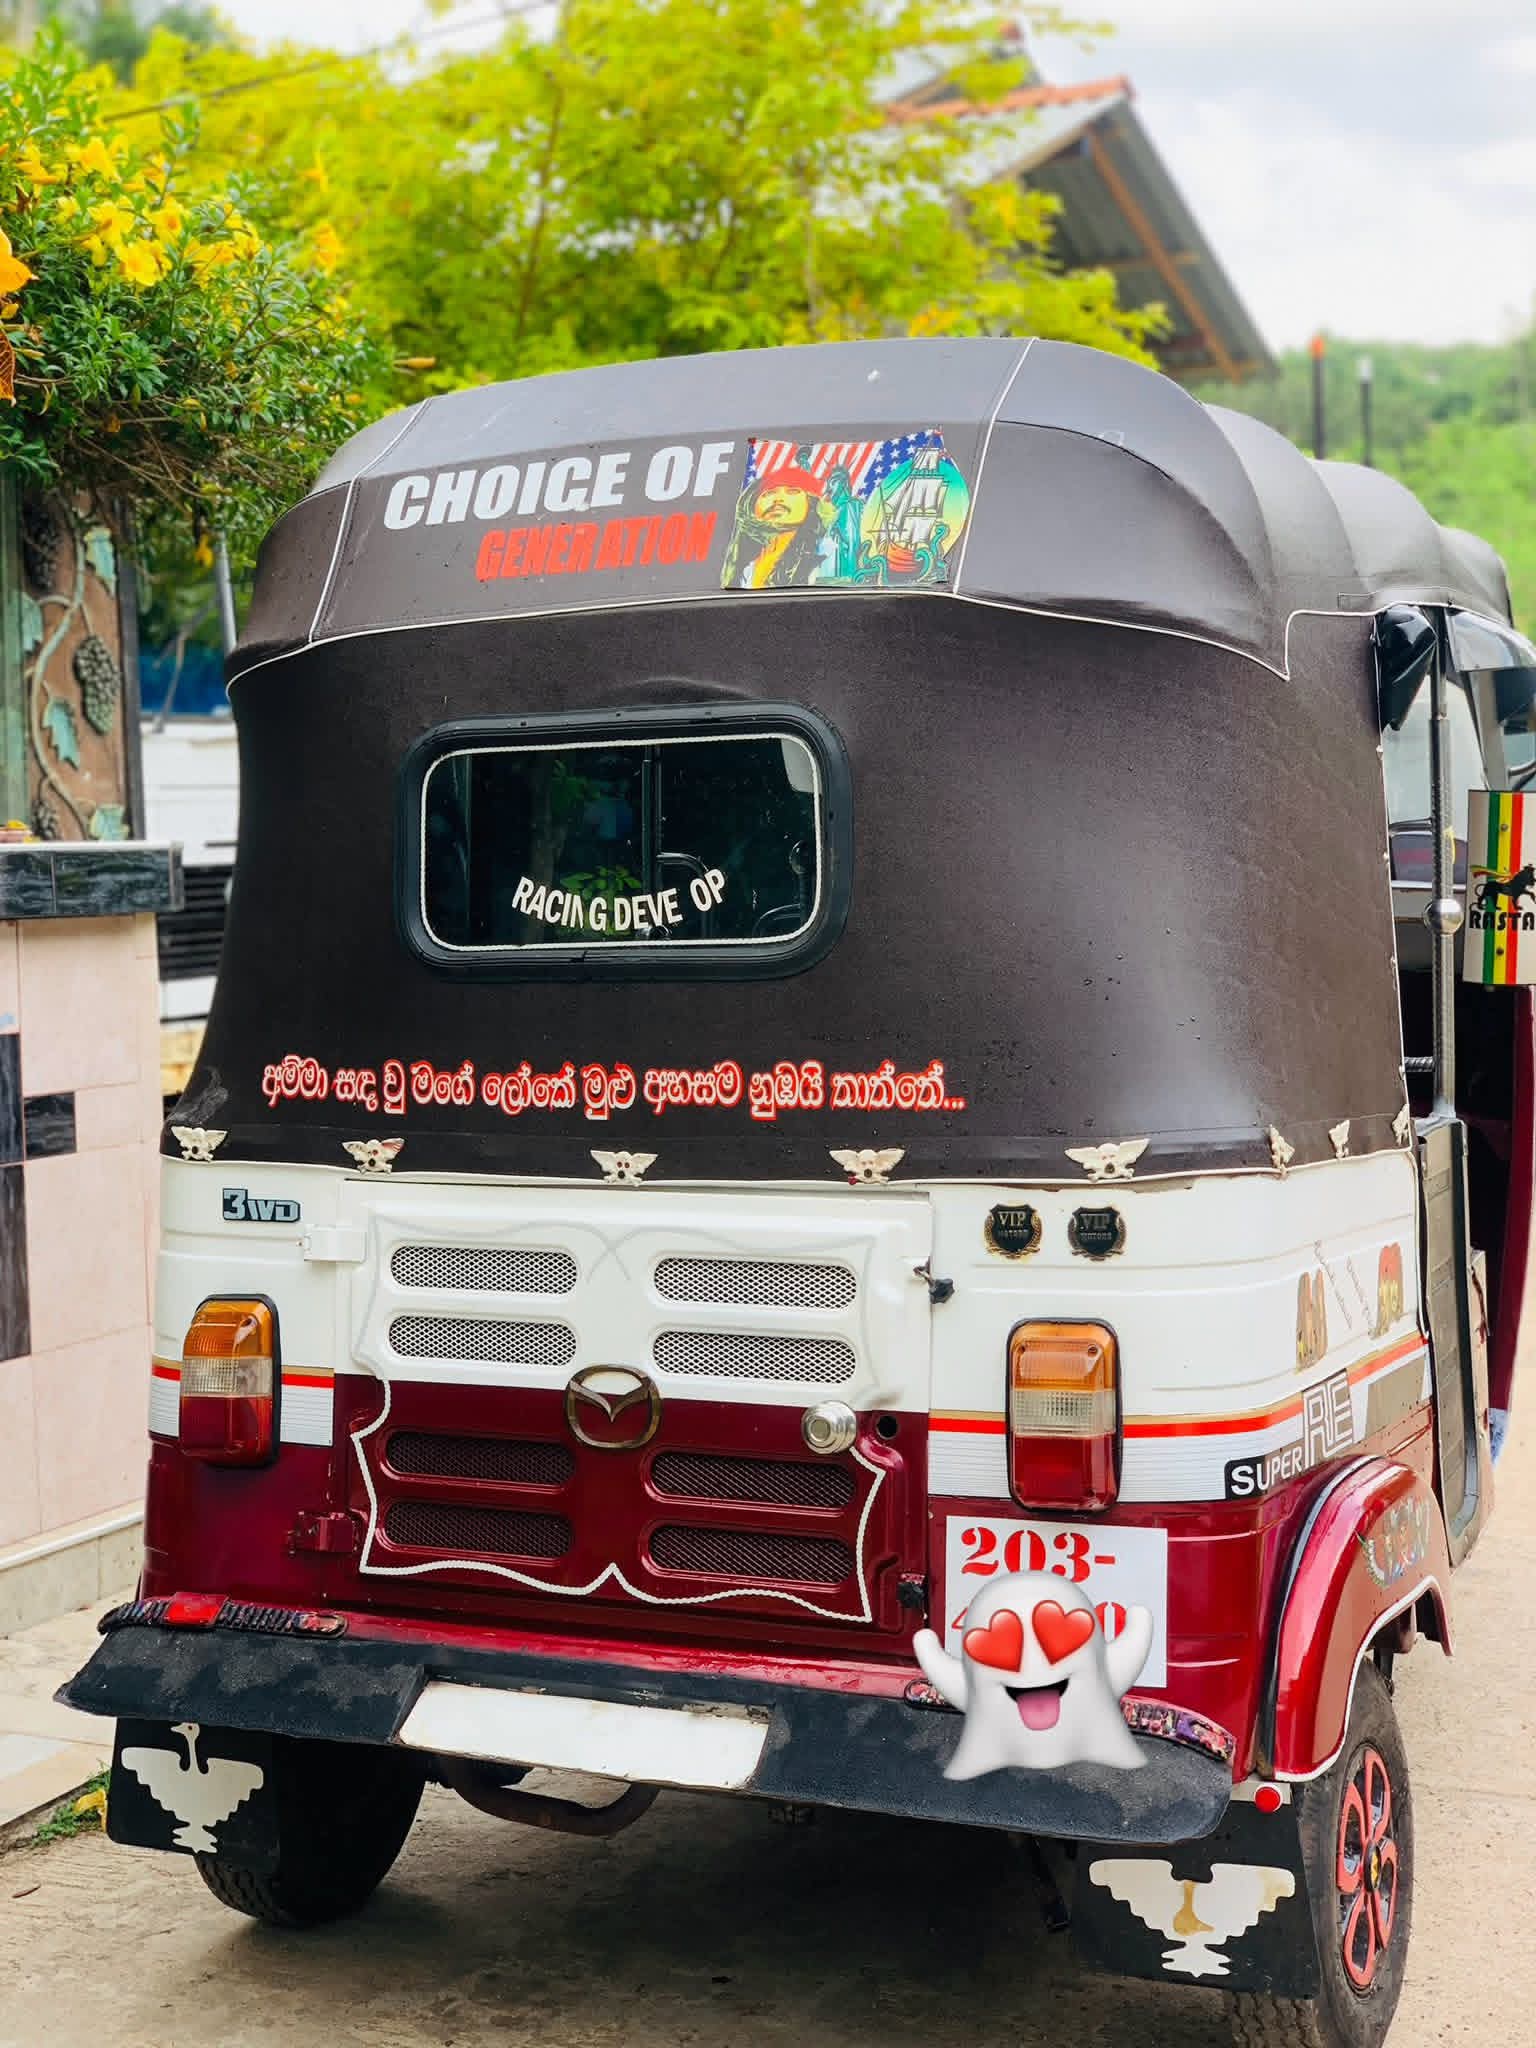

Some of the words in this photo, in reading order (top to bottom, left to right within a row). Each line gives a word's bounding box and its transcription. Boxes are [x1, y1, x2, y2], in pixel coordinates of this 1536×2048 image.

[383, 453, 627, 530] CHOICE
[645, 441, 735, 502] OF
[474, 512, 718, 583] GENERATION
[1469, 910, 1536, 931] RASTA
[261, 1053, 330, 1108] අම්මා
[410, 1060, 475, 1107] මගේ
[481, 1059, 577, 1116] ලෝකේ
[642, 1061, 744, 1115] අහසම
[749, 1059, 824, 1121] නුඹයි
[223, 1188, 300, 1223] 3WD
[998, 1210, 1027, 1227] VIP
[1230, 1446, 1303, 1497] SUPER
[960, 1526, 1117, 1583] 203-
